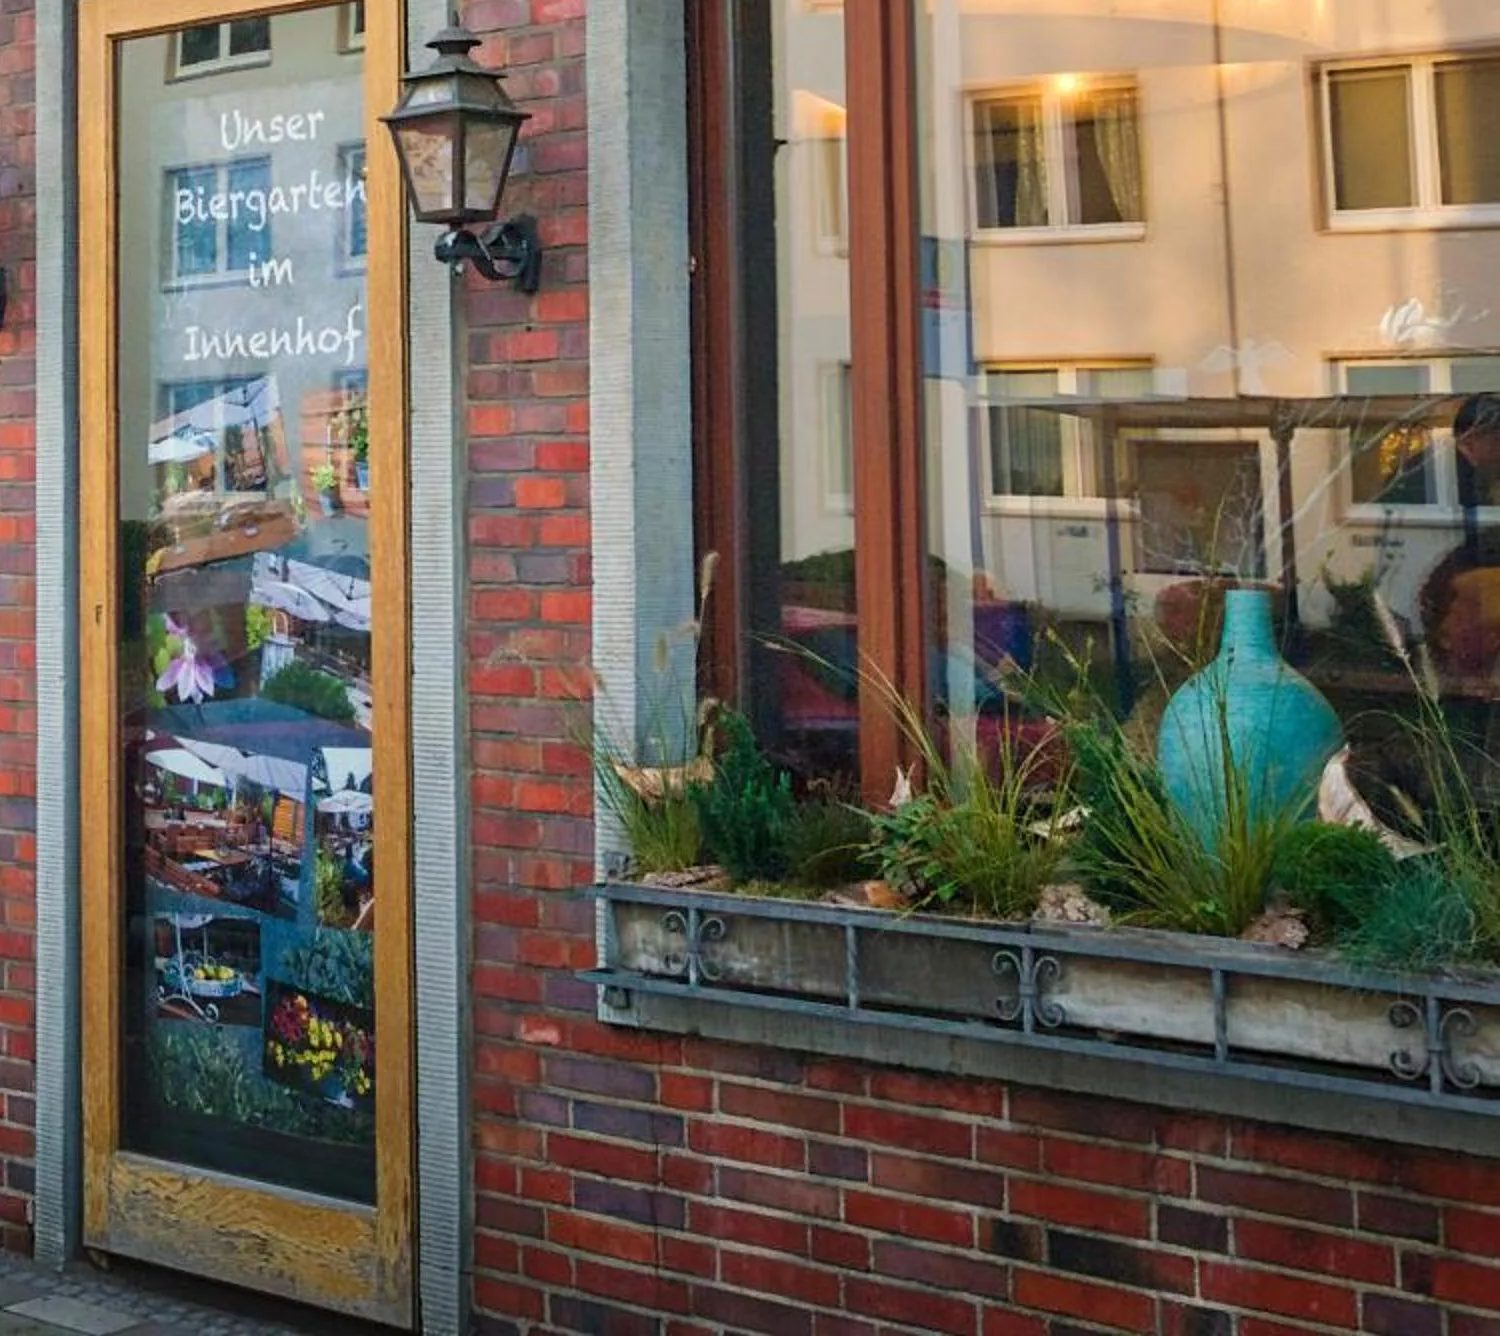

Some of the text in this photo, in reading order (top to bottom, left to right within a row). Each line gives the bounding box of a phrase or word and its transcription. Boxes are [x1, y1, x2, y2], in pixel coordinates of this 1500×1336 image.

[220, 109, 325, 150] Unser
[176, 169, 368, 231] Biergarten
[249, 251, 293, 288] im
[183, 304, 362, 363] Innenhof
